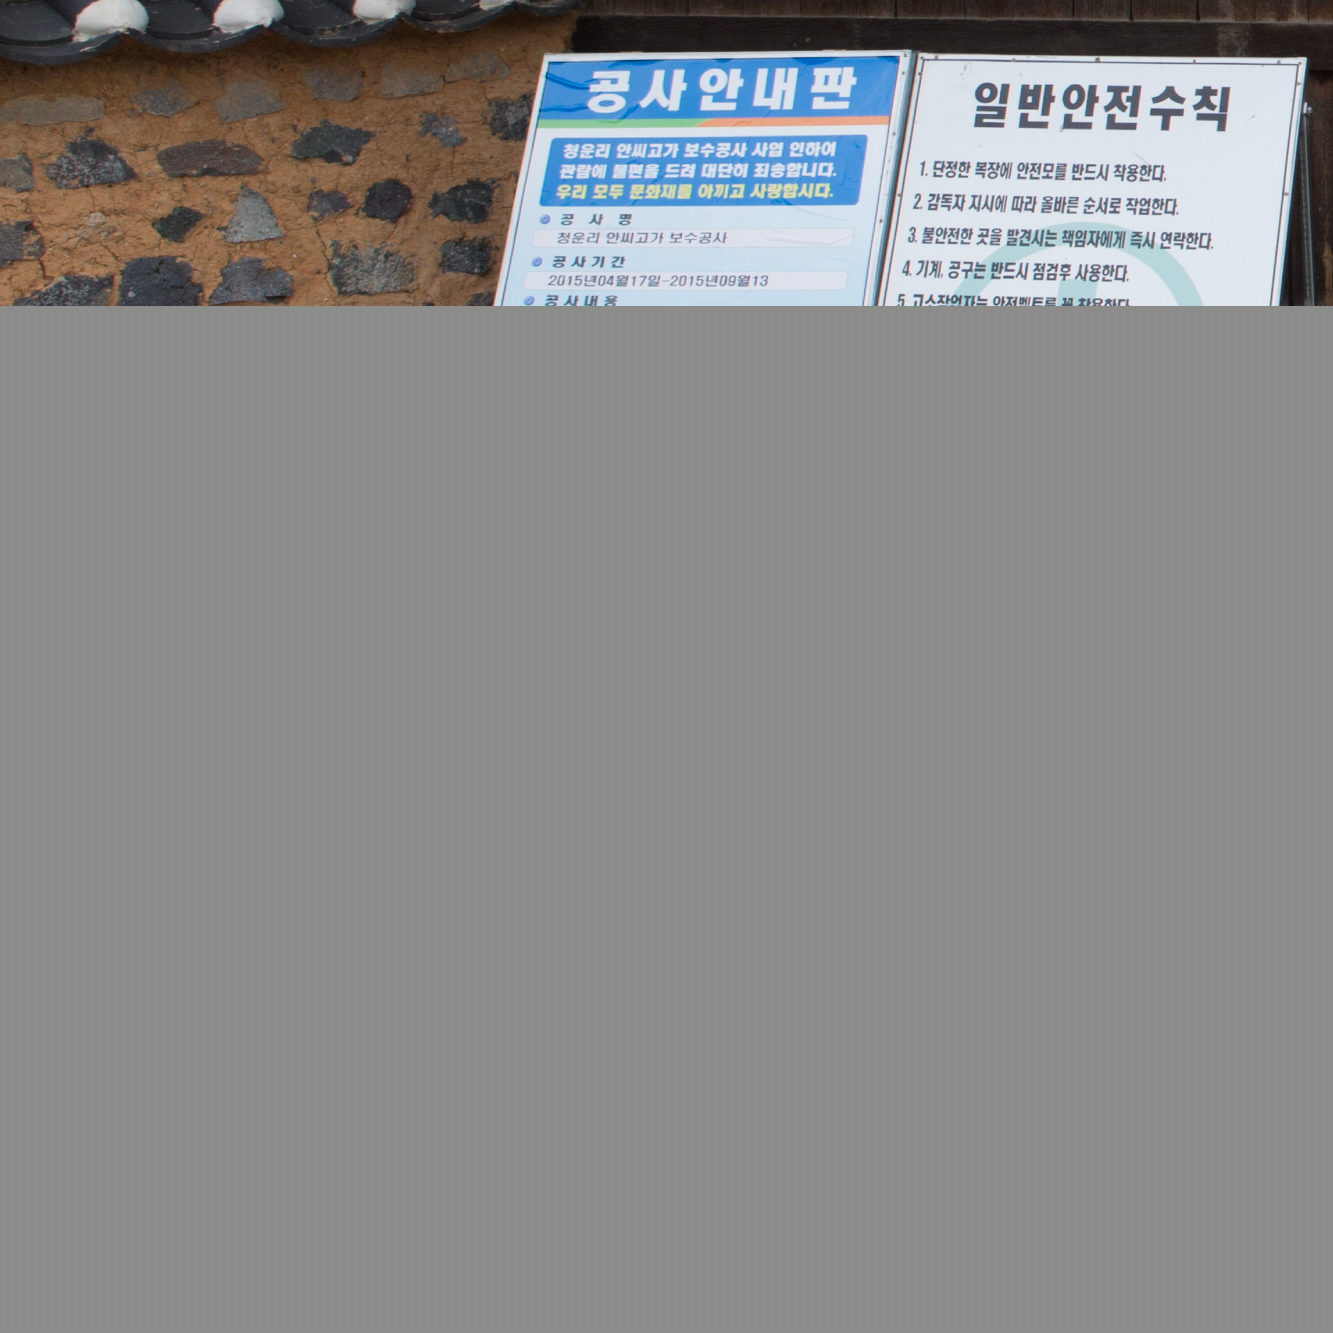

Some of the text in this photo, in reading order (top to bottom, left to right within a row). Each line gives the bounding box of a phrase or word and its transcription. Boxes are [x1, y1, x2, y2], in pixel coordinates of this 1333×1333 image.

[587, 67, 857, 113] 공사안내판
[973, 82, 1231, 132] 일반안전수칙
[563, 141, 837, 159] 청운리 안씨고가 보수공사 사업 인하여
[559, 162, 837, 180] 관람에 불편을 드려 대단히 죄송합니다.
[919, 161, 1167, 182] 1. 단정한 복장에 안전모를 반드시 착용한다.
[556, 183, 833, 200] 우리 모두 문화재를 아끼고 사랑합시다.
[913, 194, 1179, 216] 2. 감독자 지시에 따라 올바른 순서로 작업한다.
[557, 232, 728, 245] 청운리 안씨고가 보수공사
[908, 227, 1214, 251] 3. 불안전한 곳을 발견시는 책임자에게 즉시 연락한다.
[902, 260, 912, 276] 4.
[948, 261, 987, 280] 공구는
[990, 261, 1029, 280] 반드시
[1033, 263, 1072, 281] 점검후
[1074, 263, 1130, 282] 사용한다.
